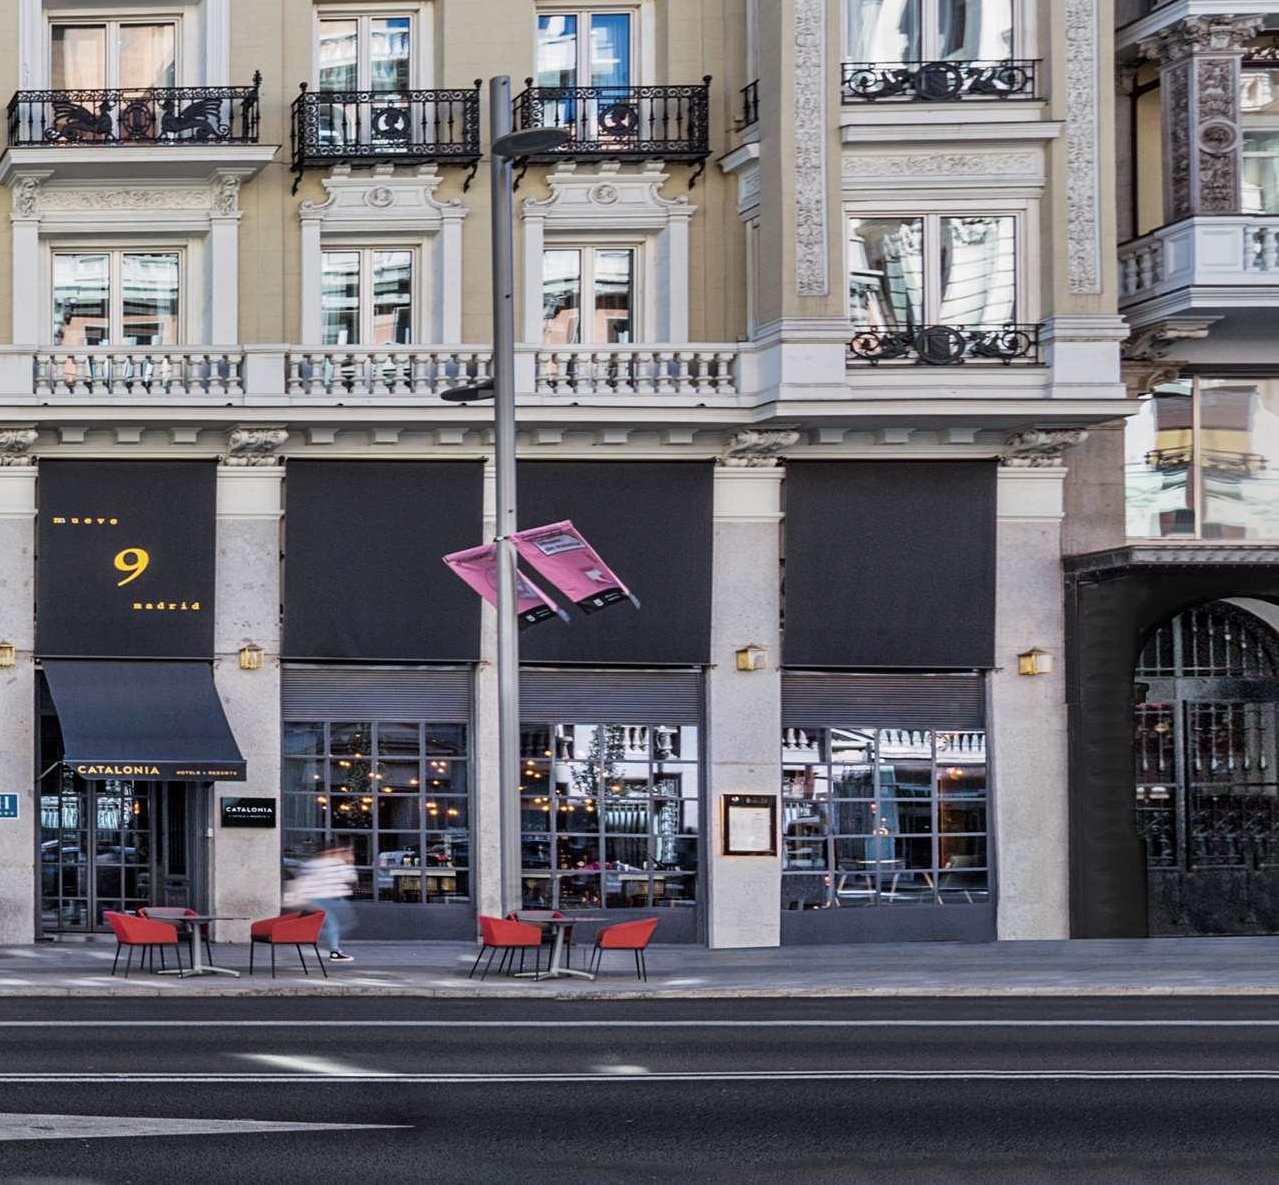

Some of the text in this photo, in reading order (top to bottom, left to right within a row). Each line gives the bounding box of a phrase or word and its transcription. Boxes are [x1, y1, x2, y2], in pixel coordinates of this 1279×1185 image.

[113, 547, 150, 587] 9
[132, 601, 201, 611] madrid
[77, 765, 160, 775] CATALONIA
